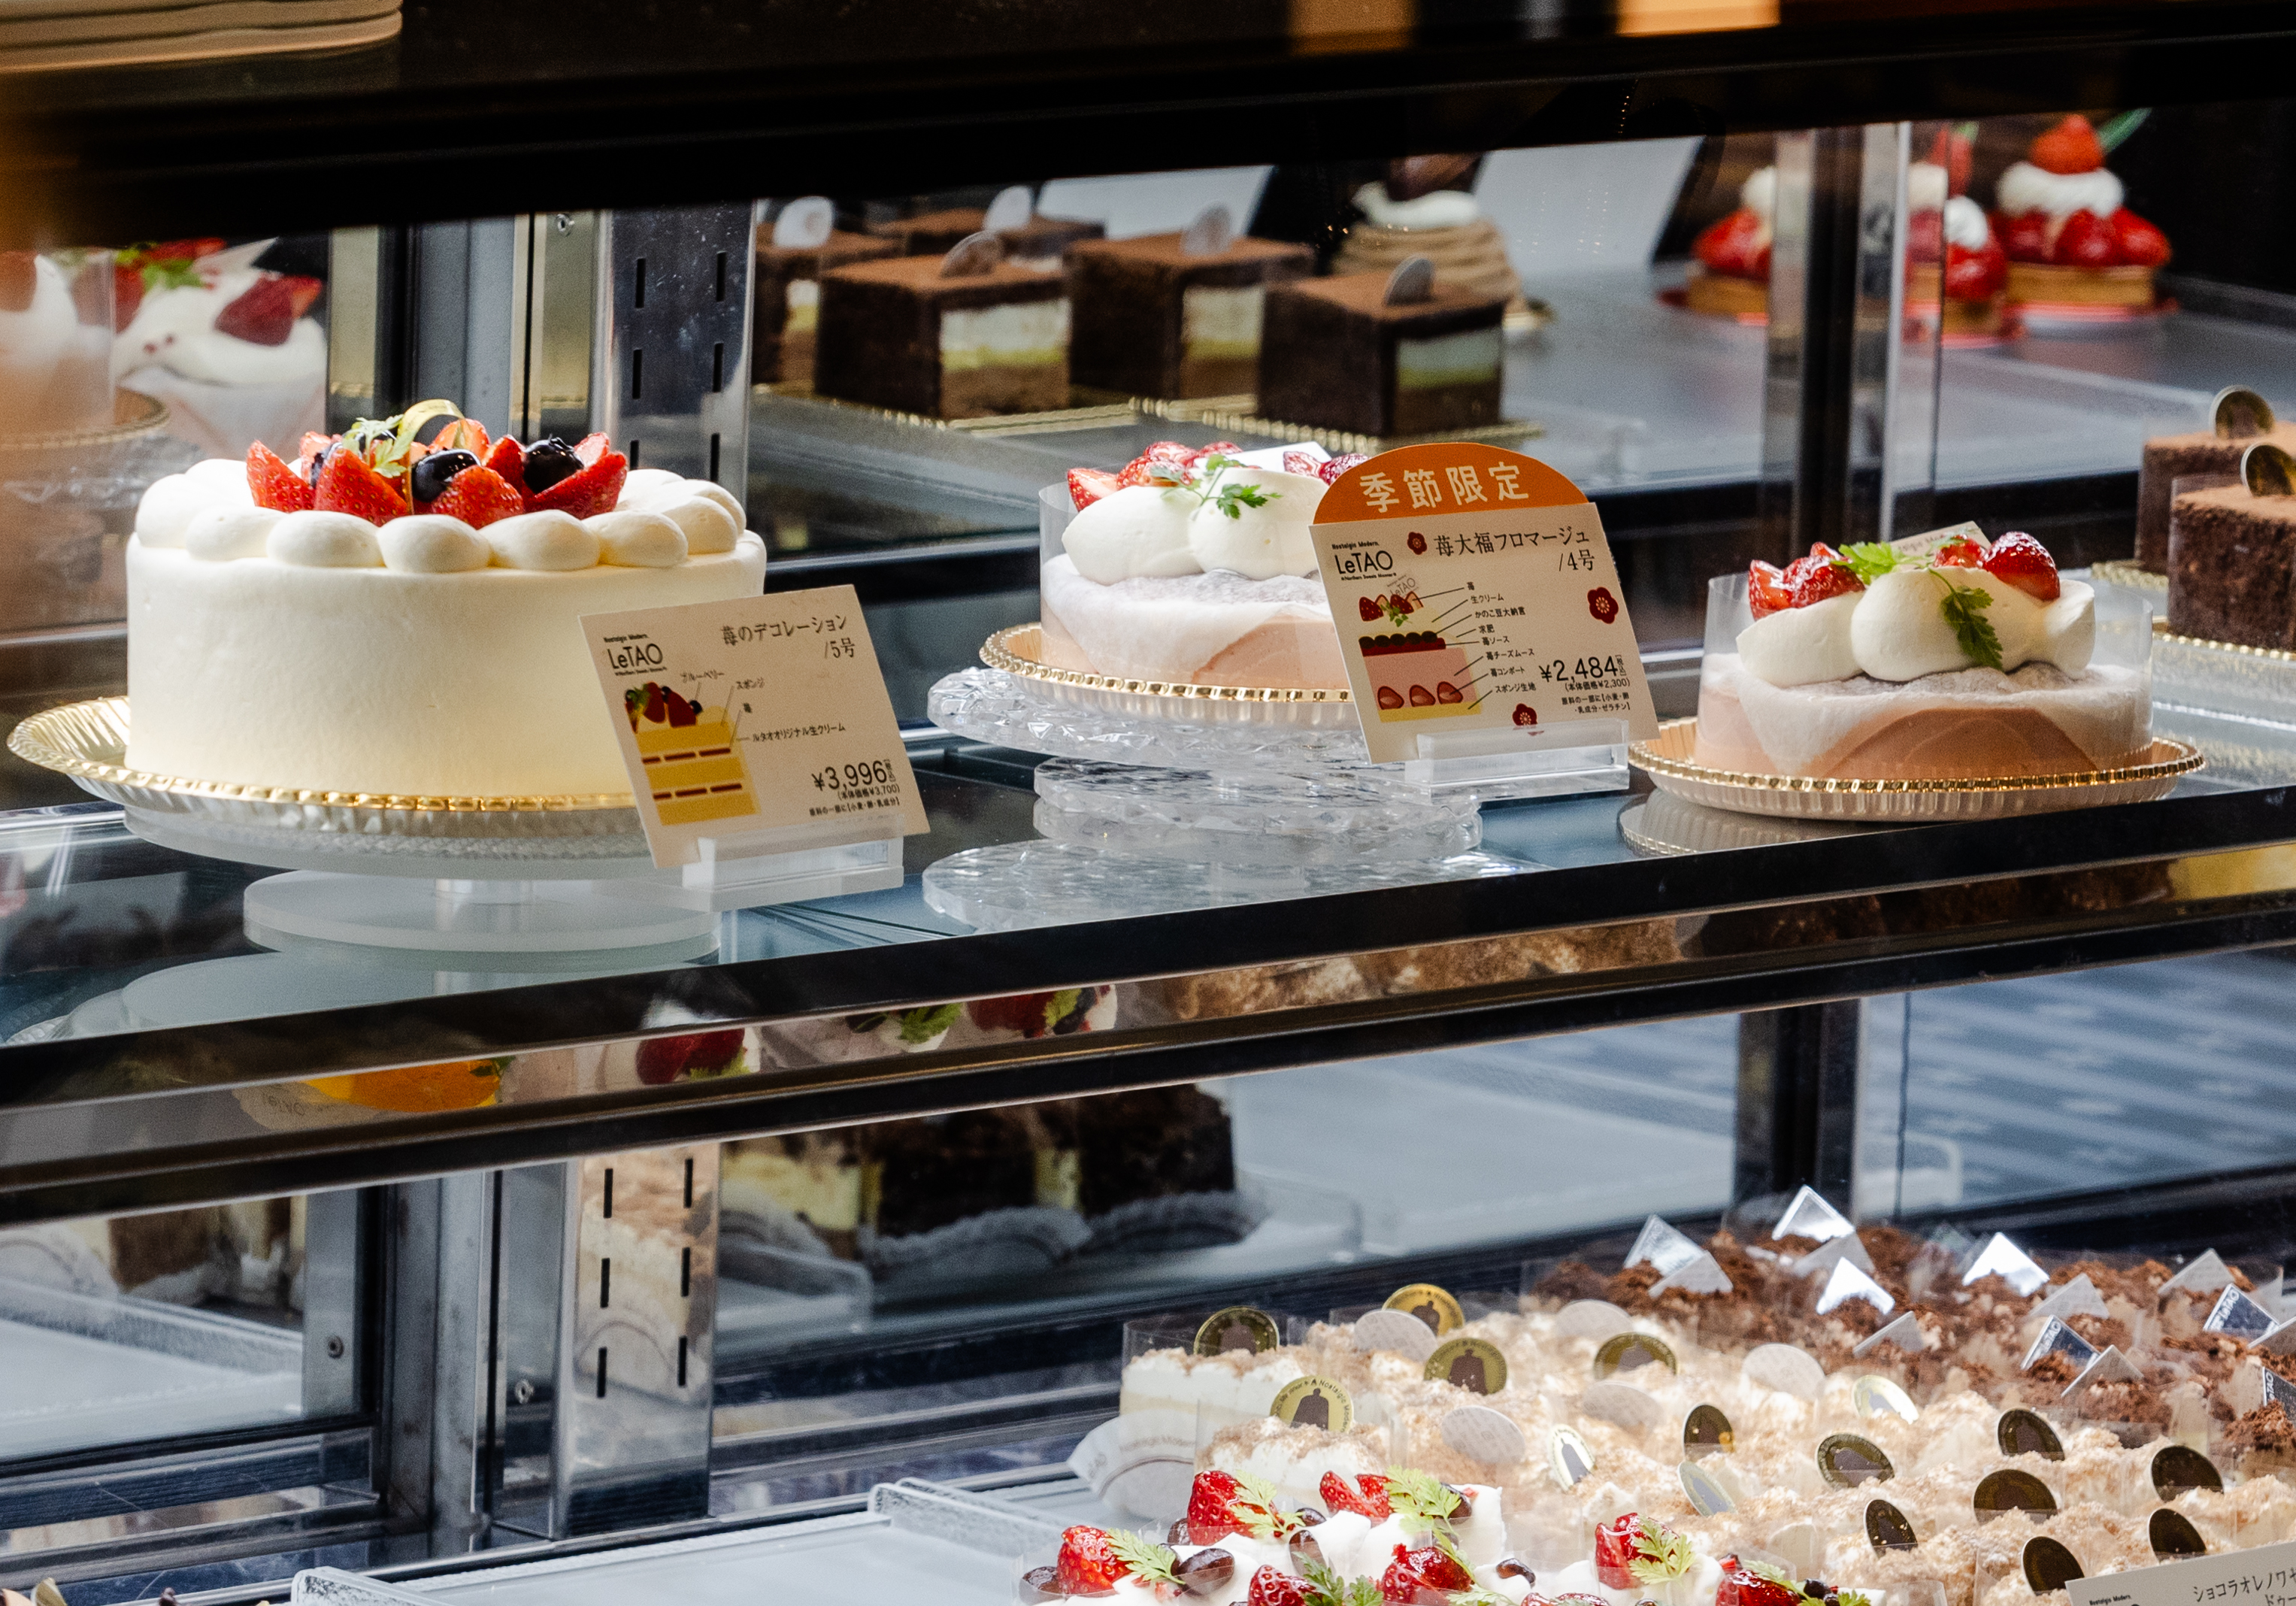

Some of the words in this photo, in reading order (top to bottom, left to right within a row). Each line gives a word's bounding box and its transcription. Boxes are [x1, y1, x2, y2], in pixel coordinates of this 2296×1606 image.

[1359, 461, 1528, 513] 季節限定
[1434, 526, 1589, 556] 苺大福フロマージュ
[1334, 550, 1393, 574] LeTAO
[1559, 549, 1595, 571] /4号
[1471, 593, 1504, 604] 生クリーム
[720, 614, 847, 646] 苺のデコレーション
[1482, 636, 1510, 646] 苺ソース
[607, 643, 663, 669] LeTAO
[824, 637, 855, 659] /5号
[1486, 648, 1535, 661] 苺チーズムース
[1538, 655, 1619, 683] ¥2,484
[1495, 682, 1537, 693] スポンジ生地
[811, 760, 887, 792] ¥3,996
